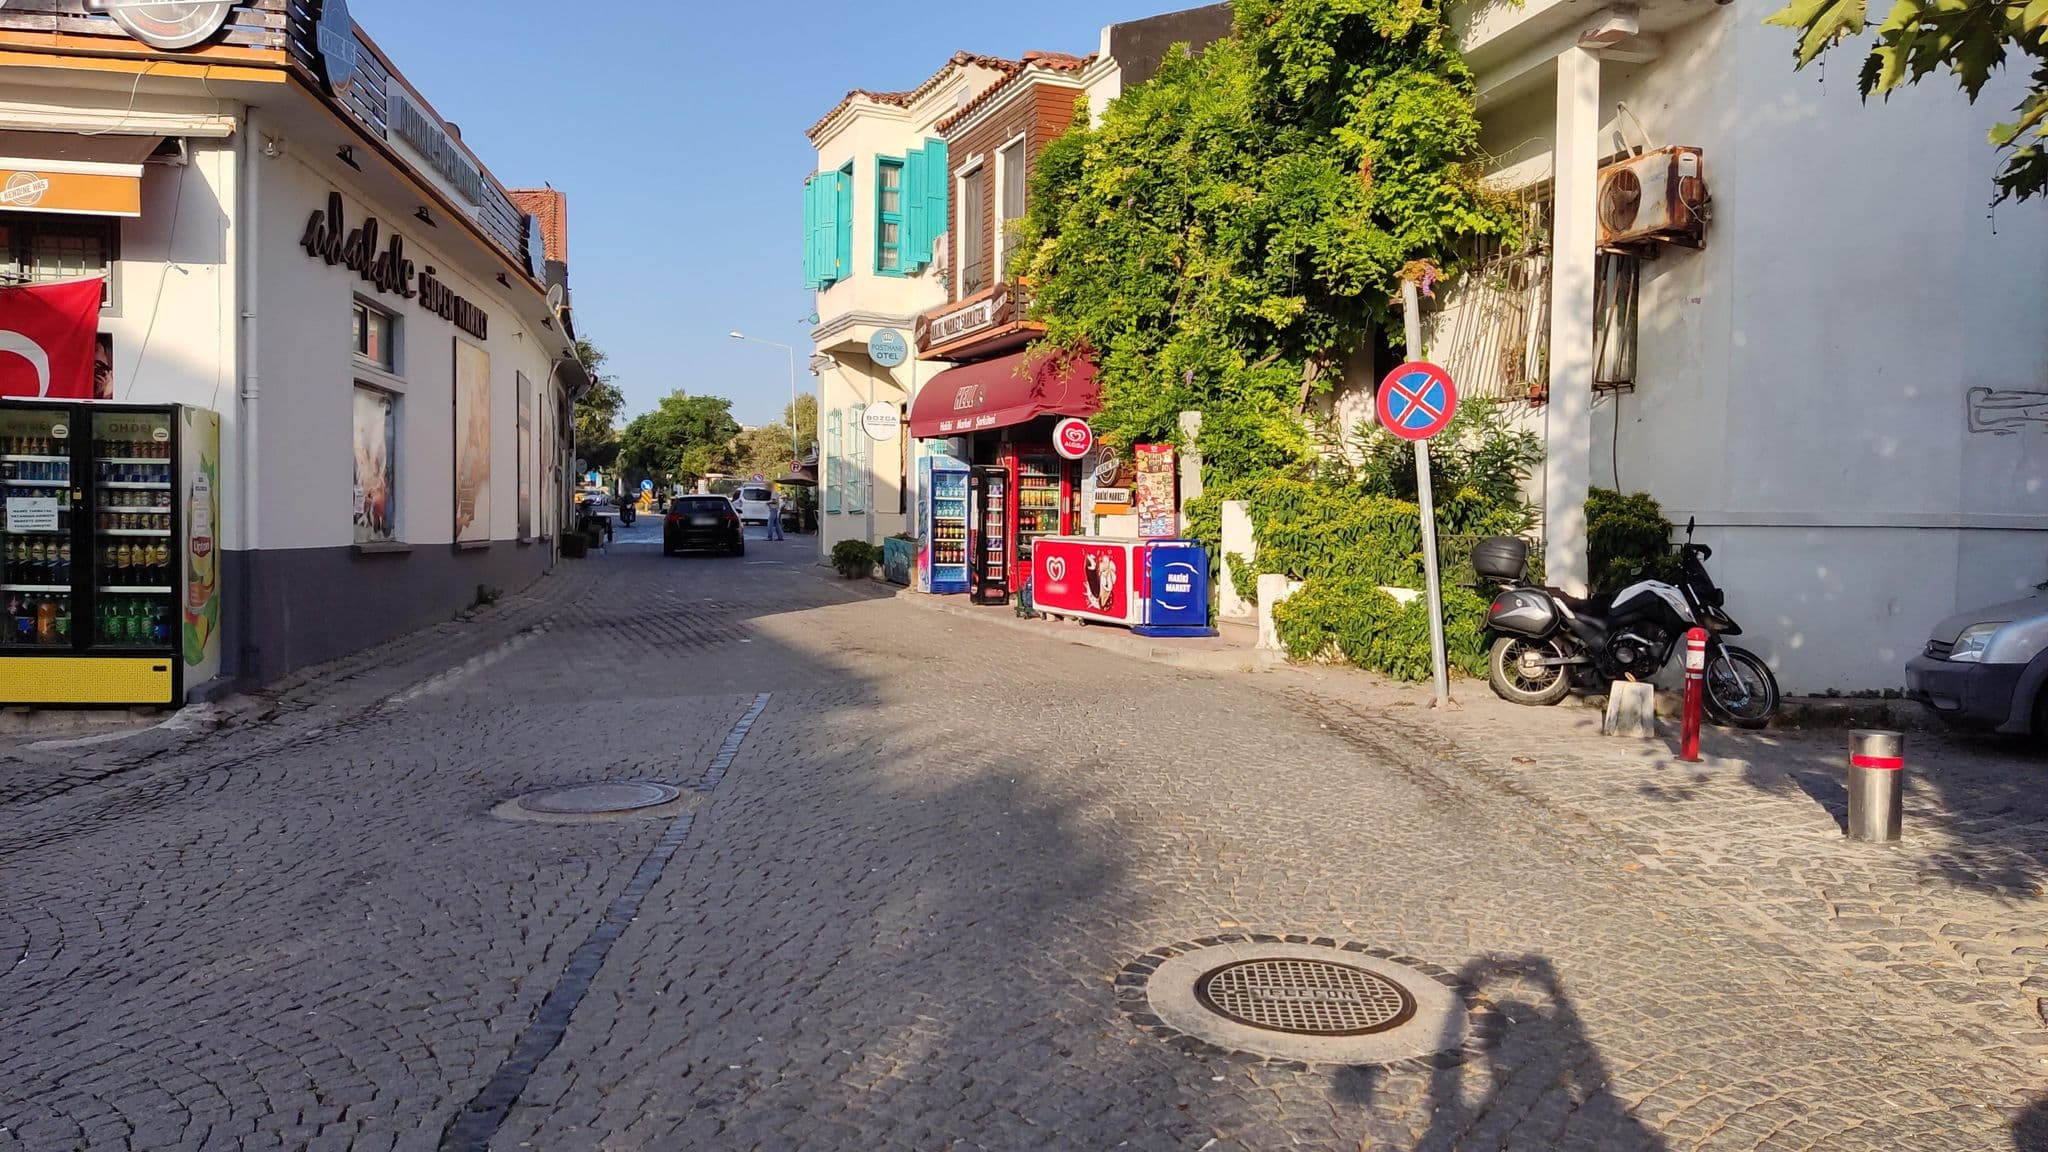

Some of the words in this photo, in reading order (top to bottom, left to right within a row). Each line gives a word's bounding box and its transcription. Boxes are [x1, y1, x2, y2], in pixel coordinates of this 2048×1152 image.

[454, 296, 488, 340] MARKET
[876, 352, 898, 360] OTEL
[1165, 583, 1191, 592] MARKET
[1256, 986, 1354, 999] TELEFON
